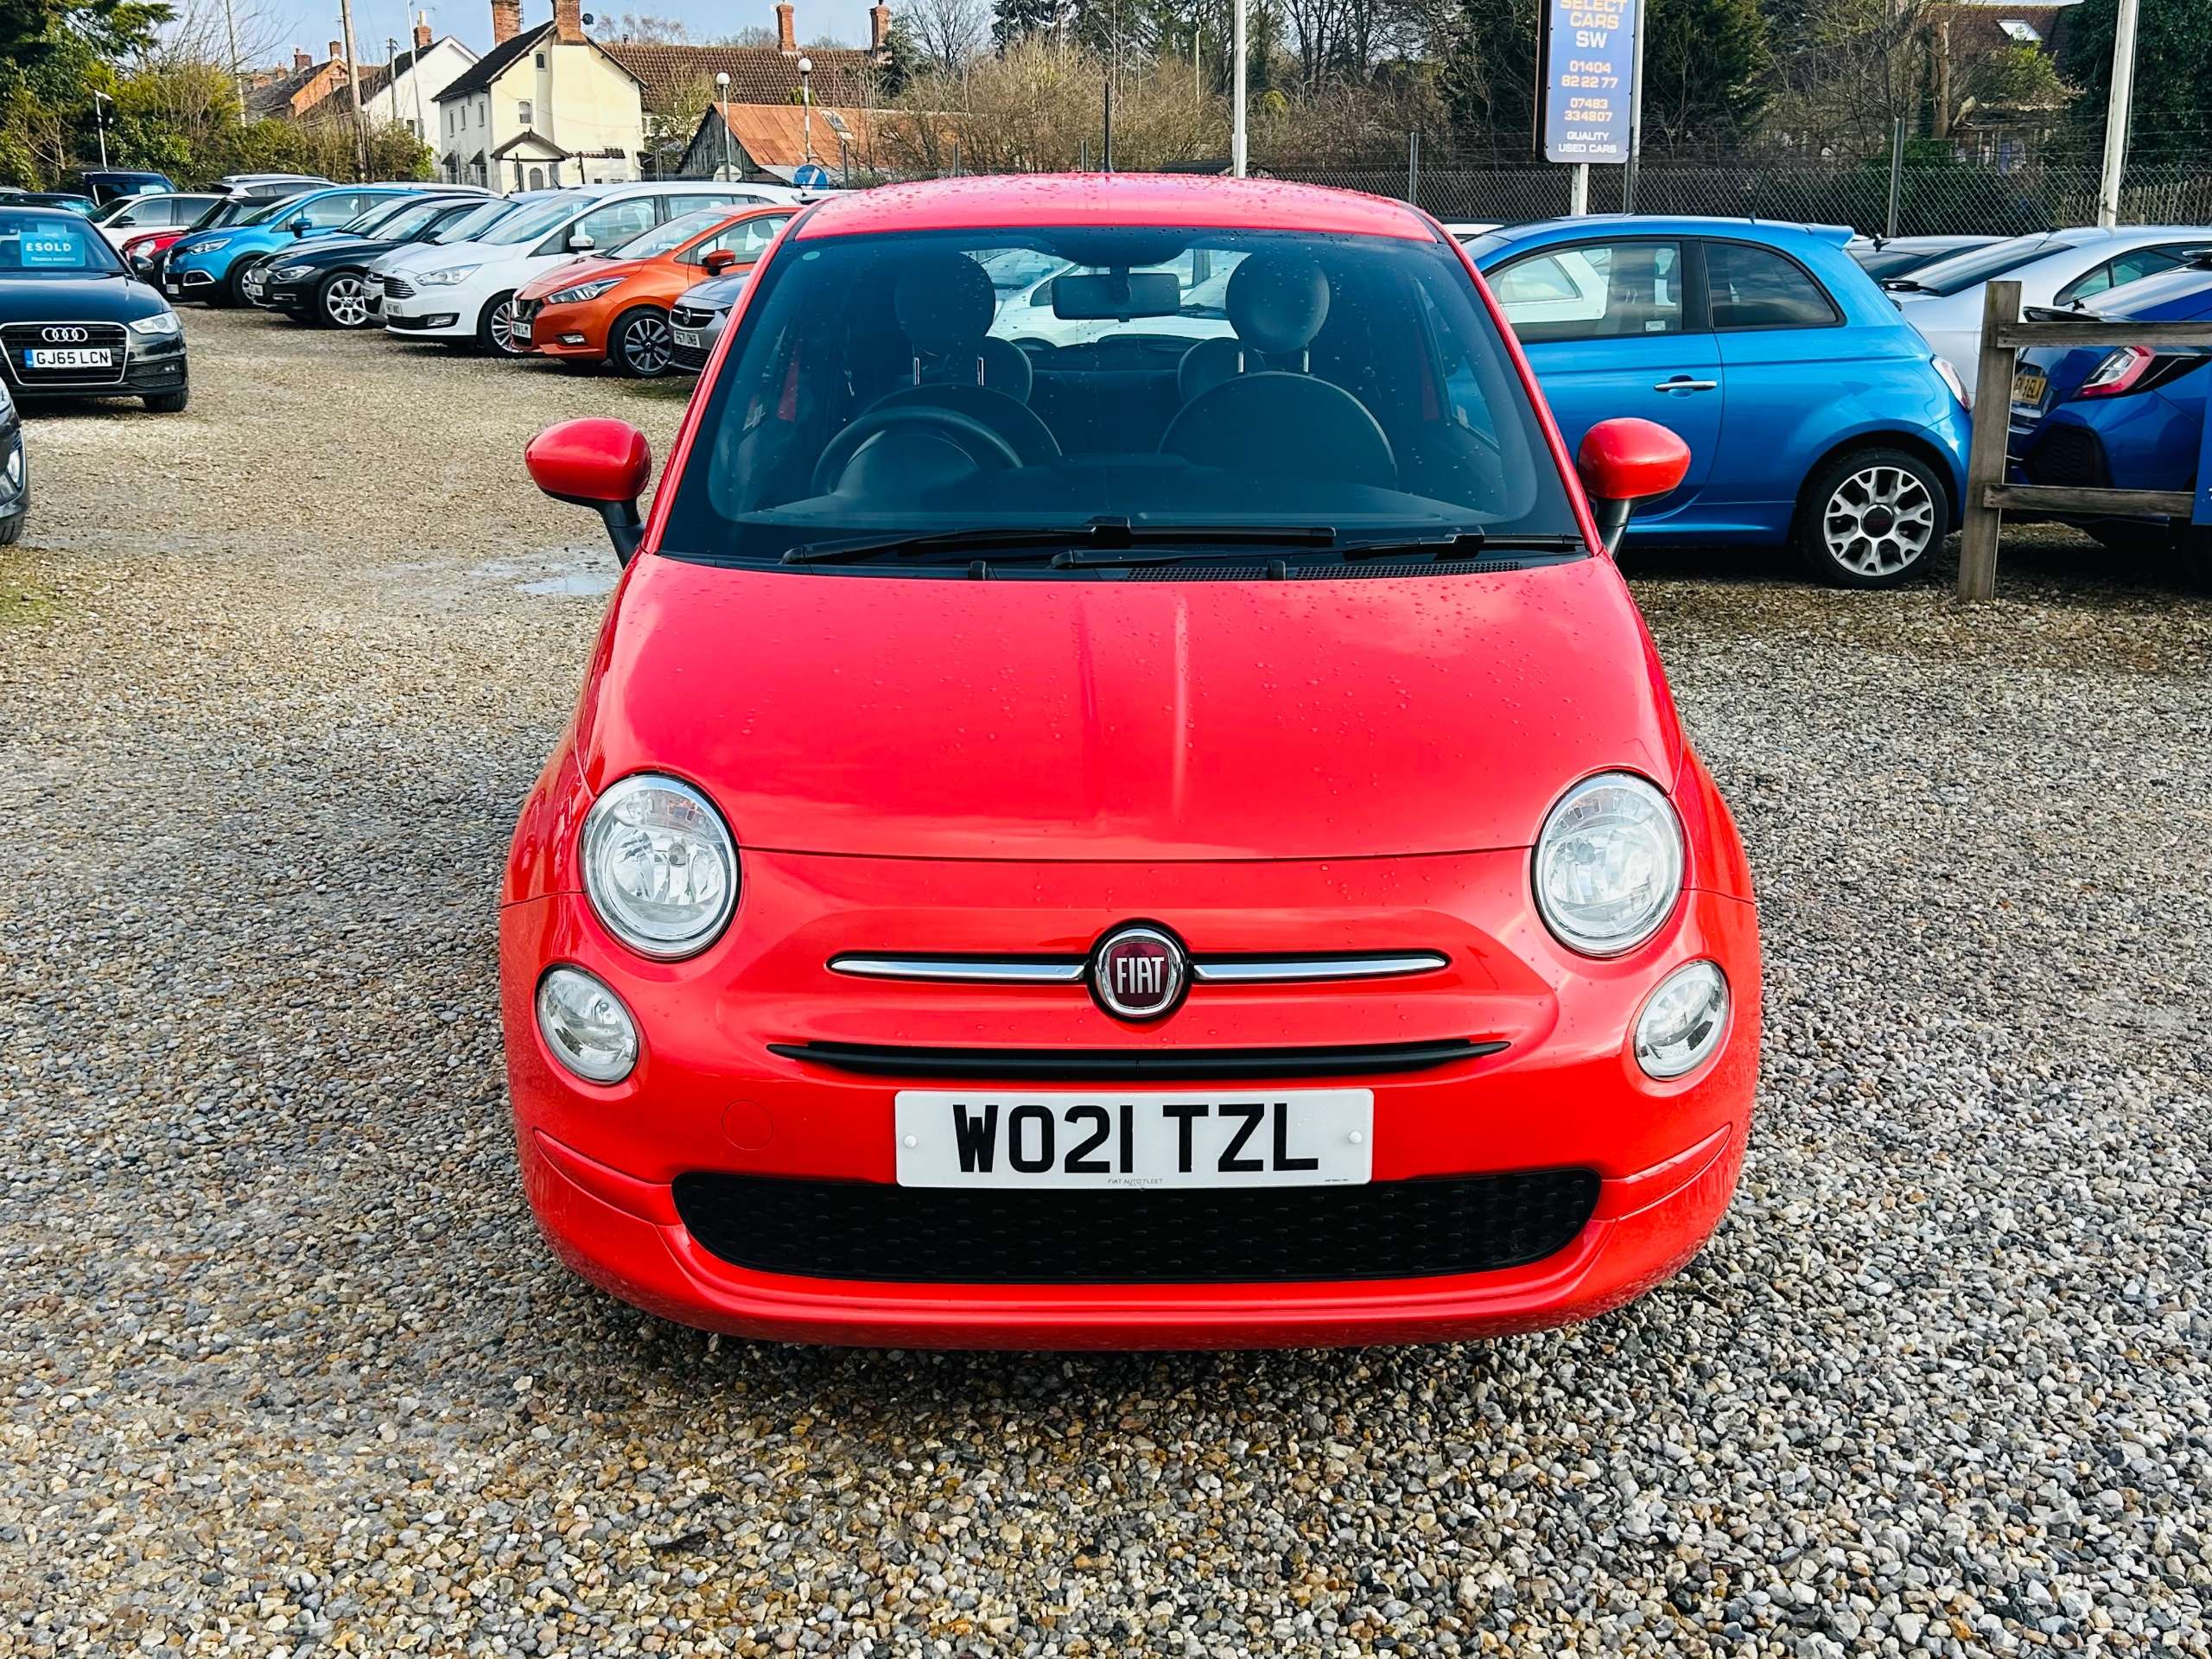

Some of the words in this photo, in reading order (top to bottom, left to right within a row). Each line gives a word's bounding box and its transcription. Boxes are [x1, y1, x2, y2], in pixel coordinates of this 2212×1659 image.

[1560, 0, 1628, 13] SELECT
[1569, 12, 1619, 29] CARS
[1575, 30, 1608, 48] SW
[1569, 60, 1611, 73] 01404
[1570, 97, 1609, 109] 07483
[1567, 130, 1610, 141] QUALITY
[1558, 143, 1586, 153] USED
[1588, 143, 1618, 154] CARS
[36, 352, 76, 365] GJ65
[79, 351, 109, 364] LCN
[1116, 957, 1165, 994] FIAT
[953, 1104, 1133, 1173] WO21
[1162, 1103, 1319, 1173] TZL
